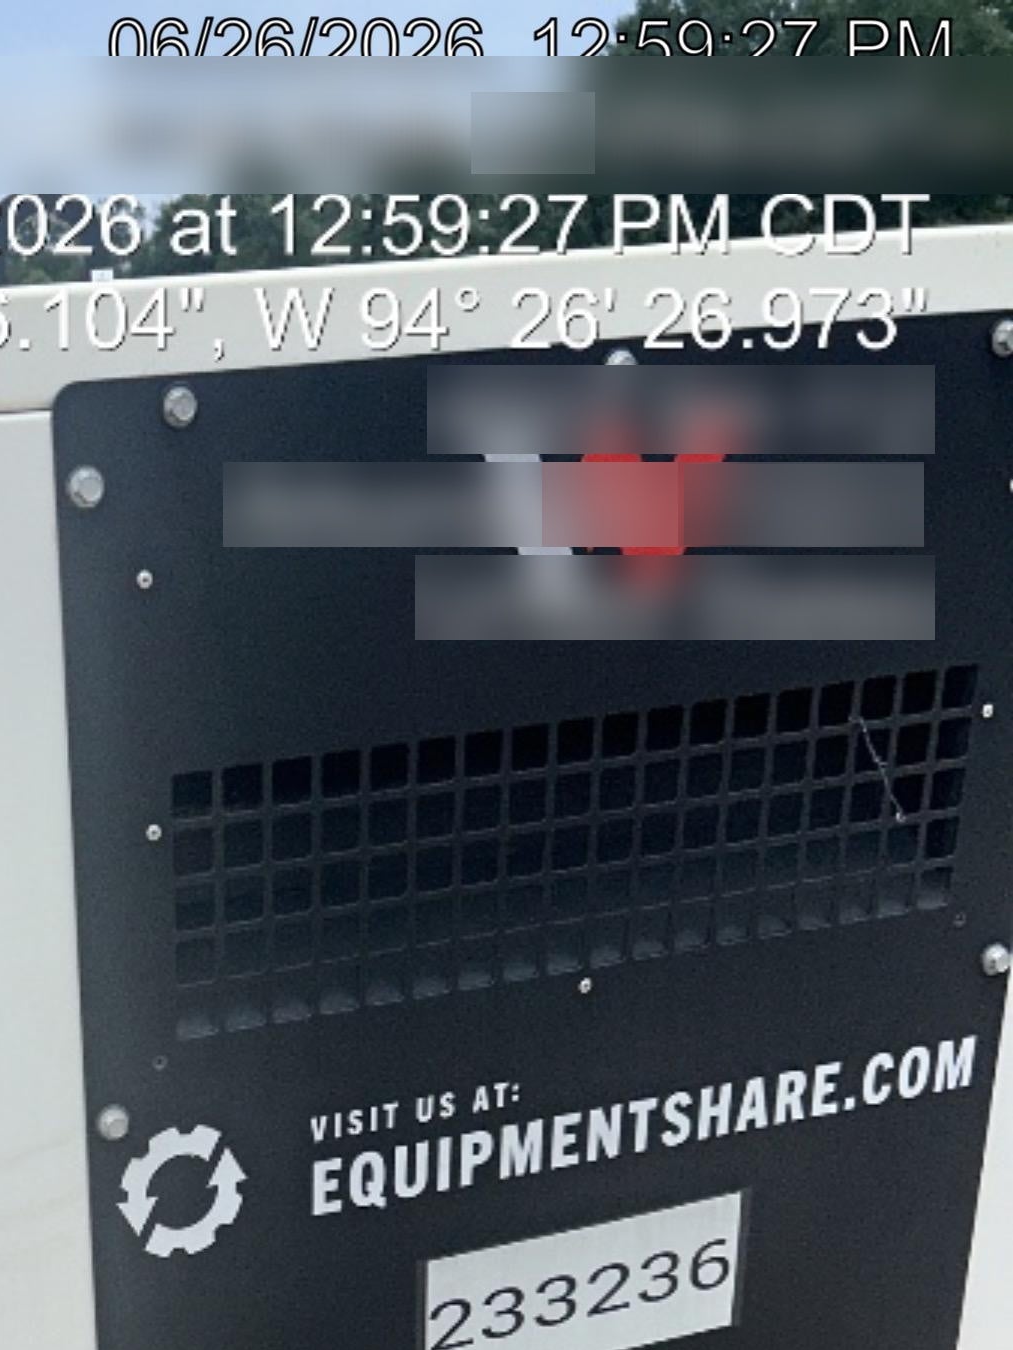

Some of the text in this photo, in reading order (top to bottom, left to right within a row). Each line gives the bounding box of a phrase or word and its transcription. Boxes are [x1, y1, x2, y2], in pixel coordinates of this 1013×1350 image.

[309, 1034, 978, 1217] EQUIPMENTSHARE.COM
[310, 1081, 522, 1143] VISIT US AT:
